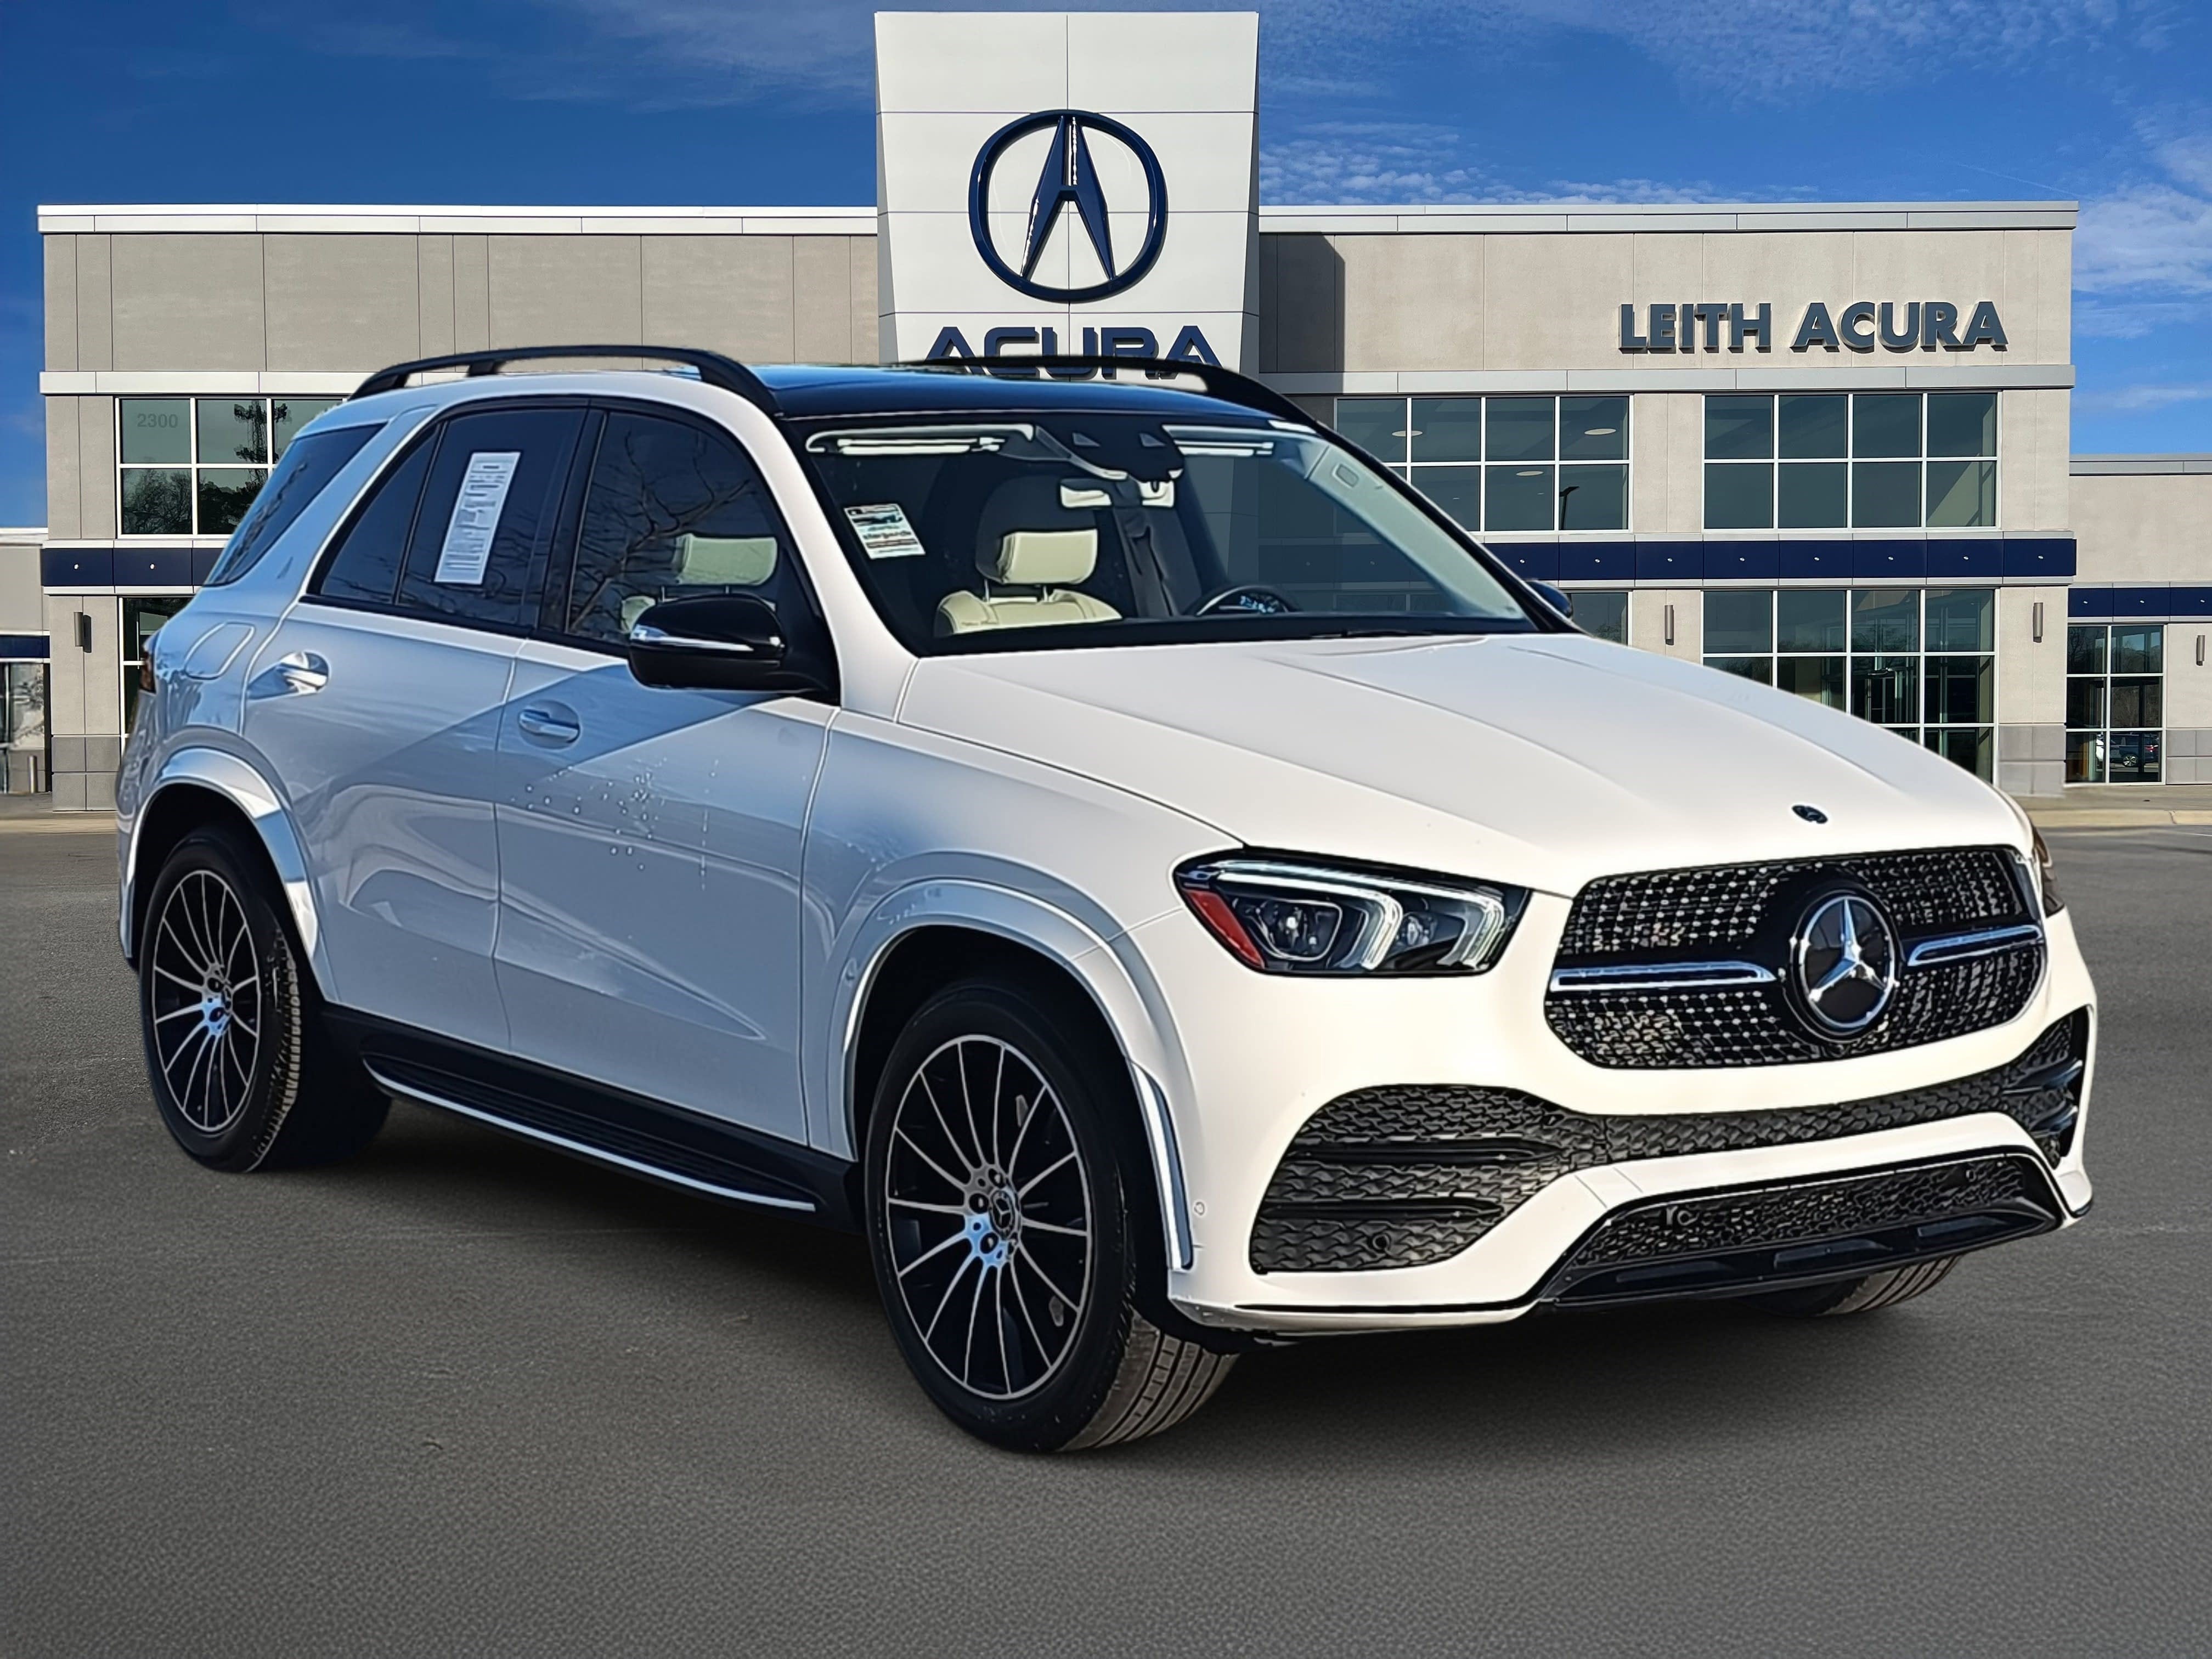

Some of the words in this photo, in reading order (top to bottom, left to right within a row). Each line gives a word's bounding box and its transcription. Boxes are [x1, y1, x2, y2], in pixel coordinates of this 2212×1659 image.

[925, 326, 1223, 379] ACURA
[1619, 303, 1771, 353] LEITH
[1790, 301, 2008, 353] ACURA
[137, 413, 178, 428] 2300
